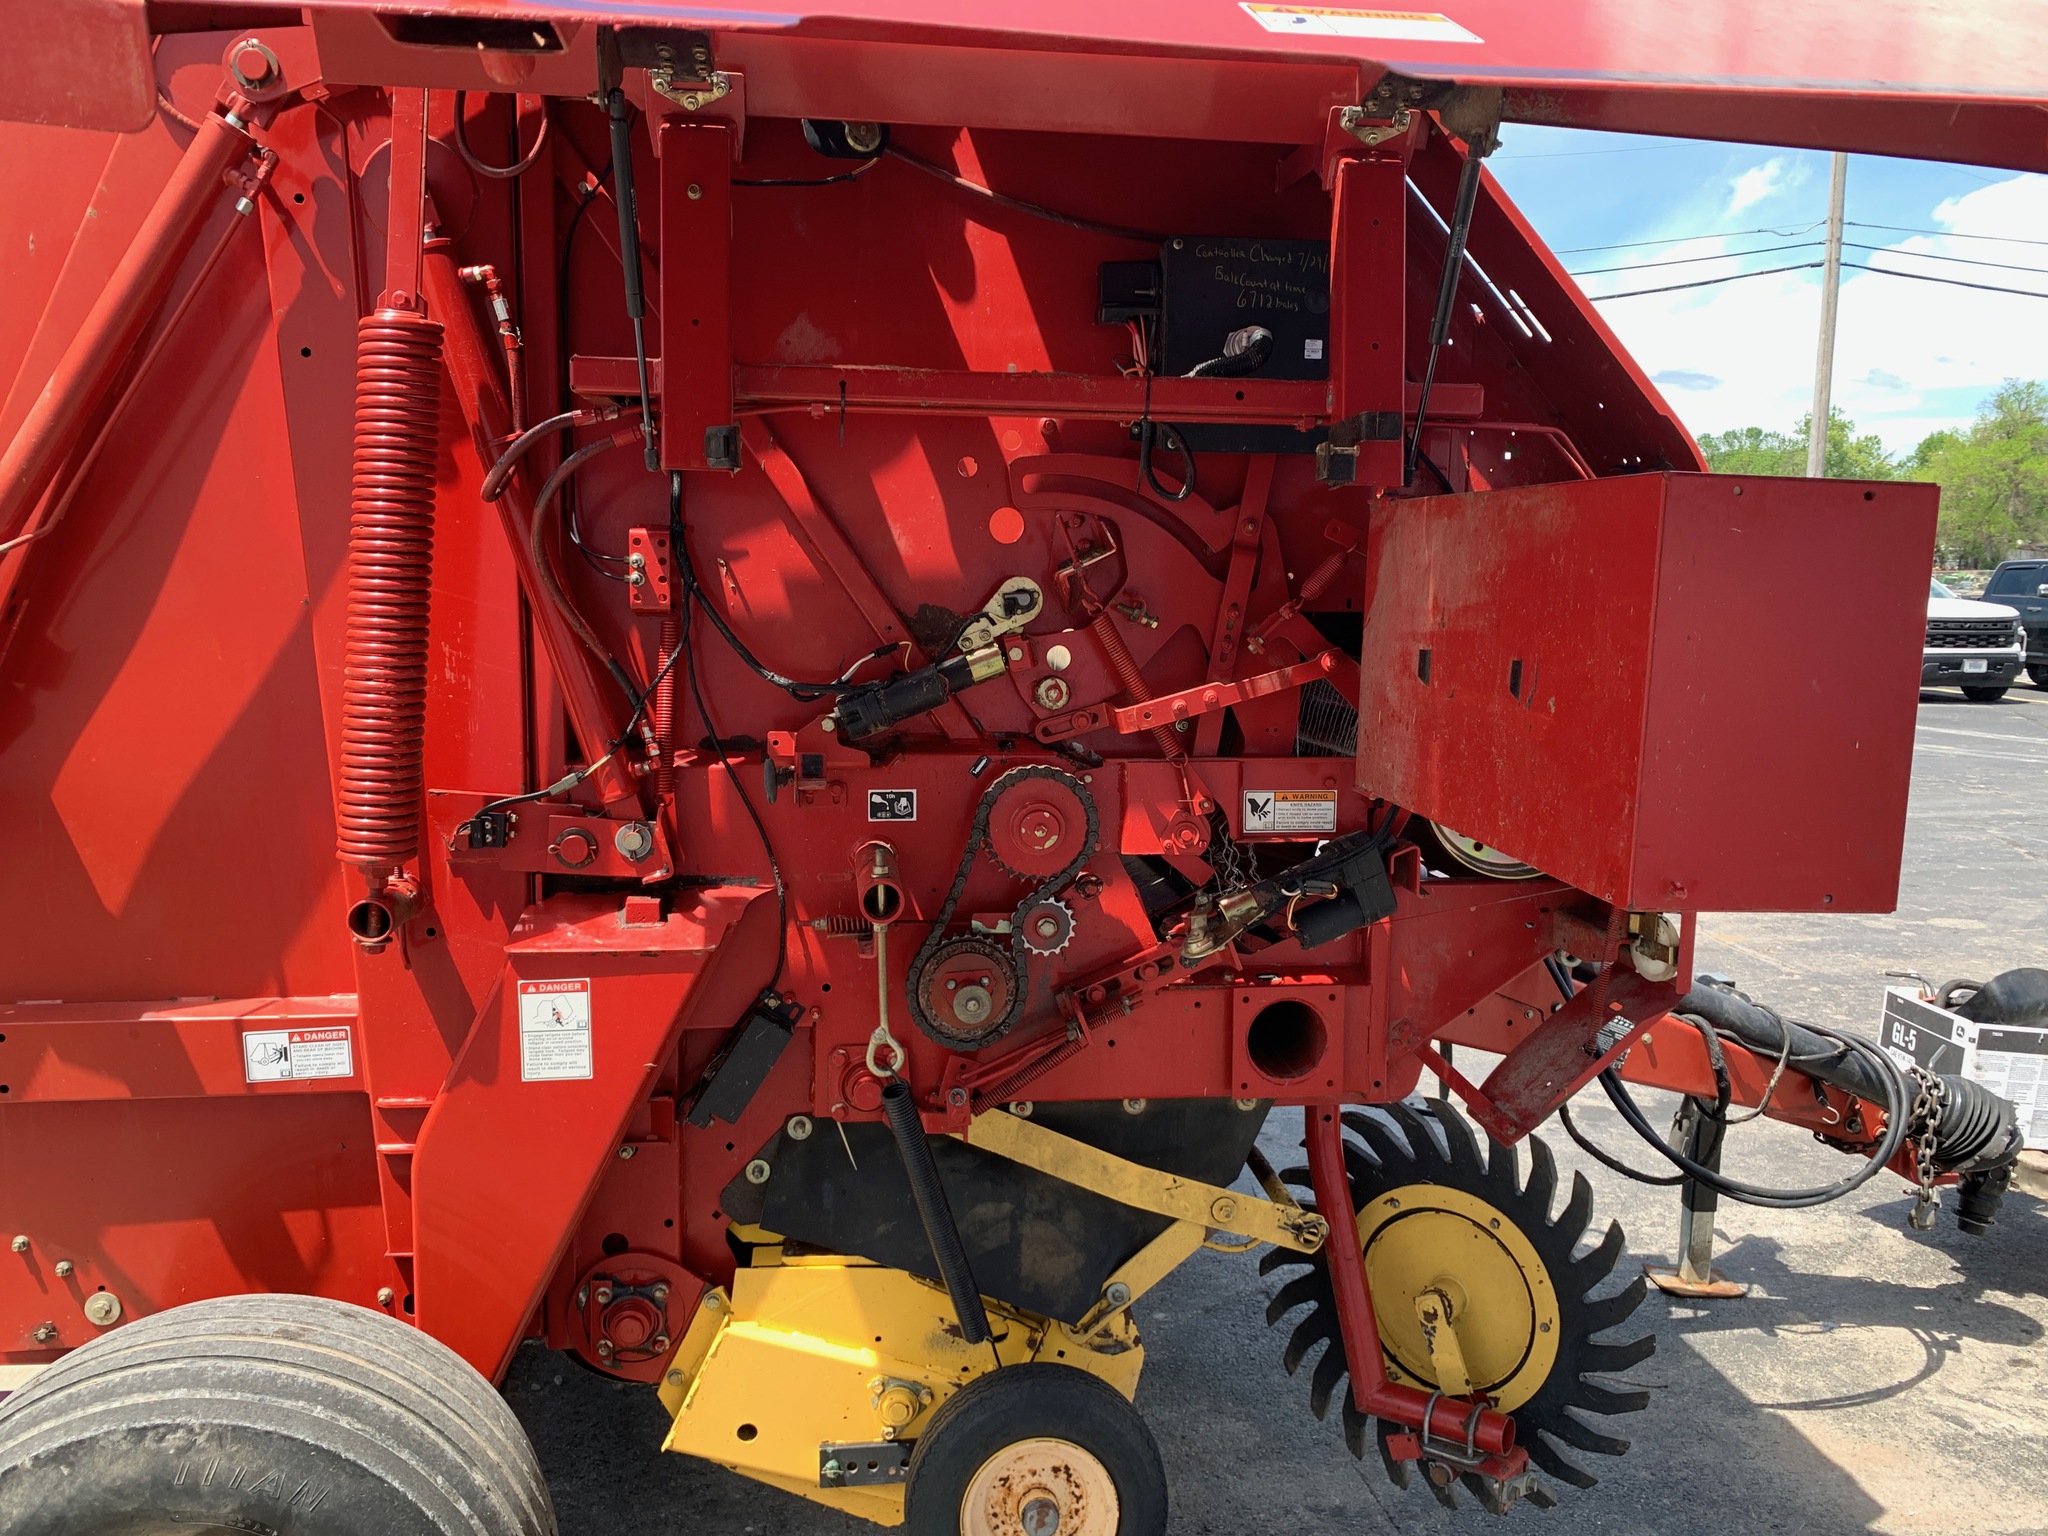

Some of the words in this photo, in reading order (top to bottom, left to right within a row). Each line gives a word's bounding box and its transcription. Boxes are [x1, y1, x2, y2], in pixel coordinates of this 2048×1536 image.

[1269, 280, 1280, 291] at
[1285, 281, 1306, 294] time
[1236, 288, 1273, 308] 6712
[539, 984, 581, 992] DANGER
[303, 1032, 346, 1041] DANGER
[1892, 1022, 1918, 1051] GL-5
[174, 1457, 331, 1512] TITAN
